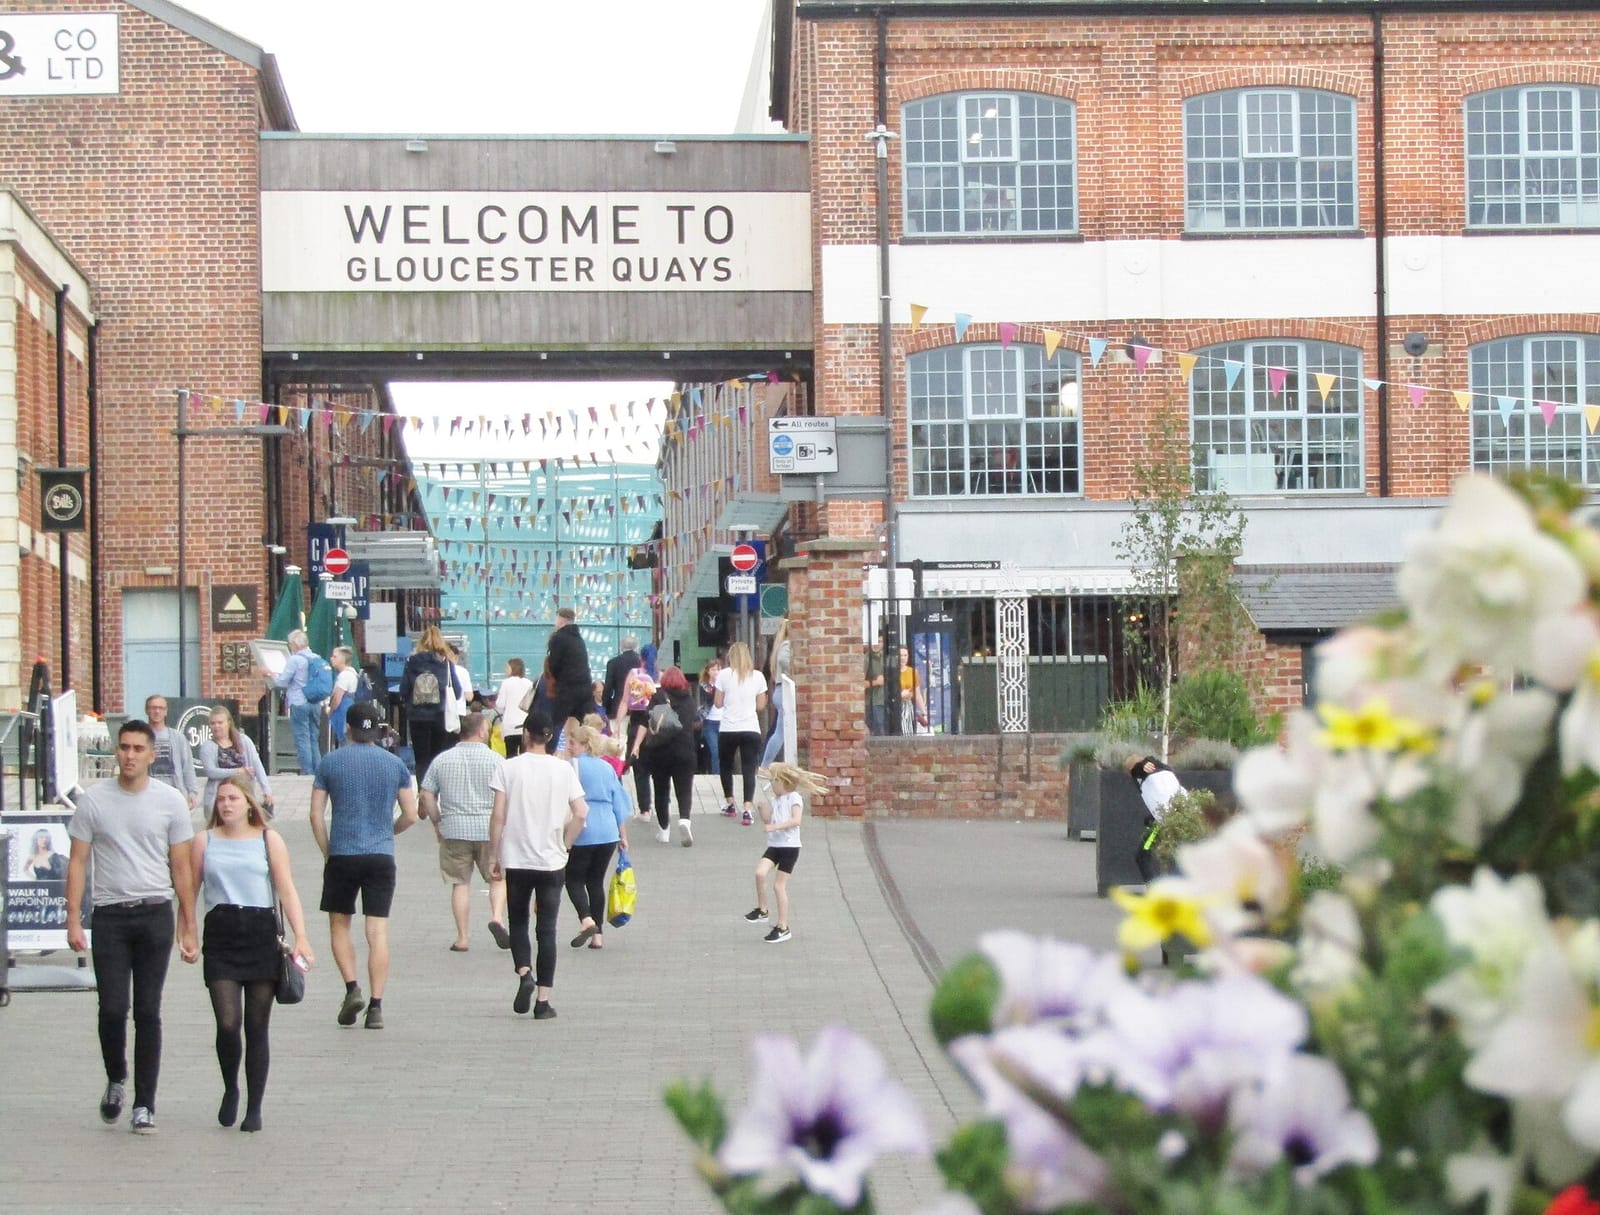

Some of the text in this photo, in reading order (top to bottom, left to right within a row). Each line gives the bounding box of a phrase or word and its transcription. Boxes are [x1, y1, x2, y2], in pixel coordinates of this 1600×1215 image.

[54, 28, 97, 51] CO
[47, 57, 104, 80] LTD
[344, 204, 734, 245] WELCOME TO
[346, 256, 732, 284] GLOUCESTER QUAYS
[804, 420, 829, 428] routes
[8, 888, 49, 897] WALK IN
